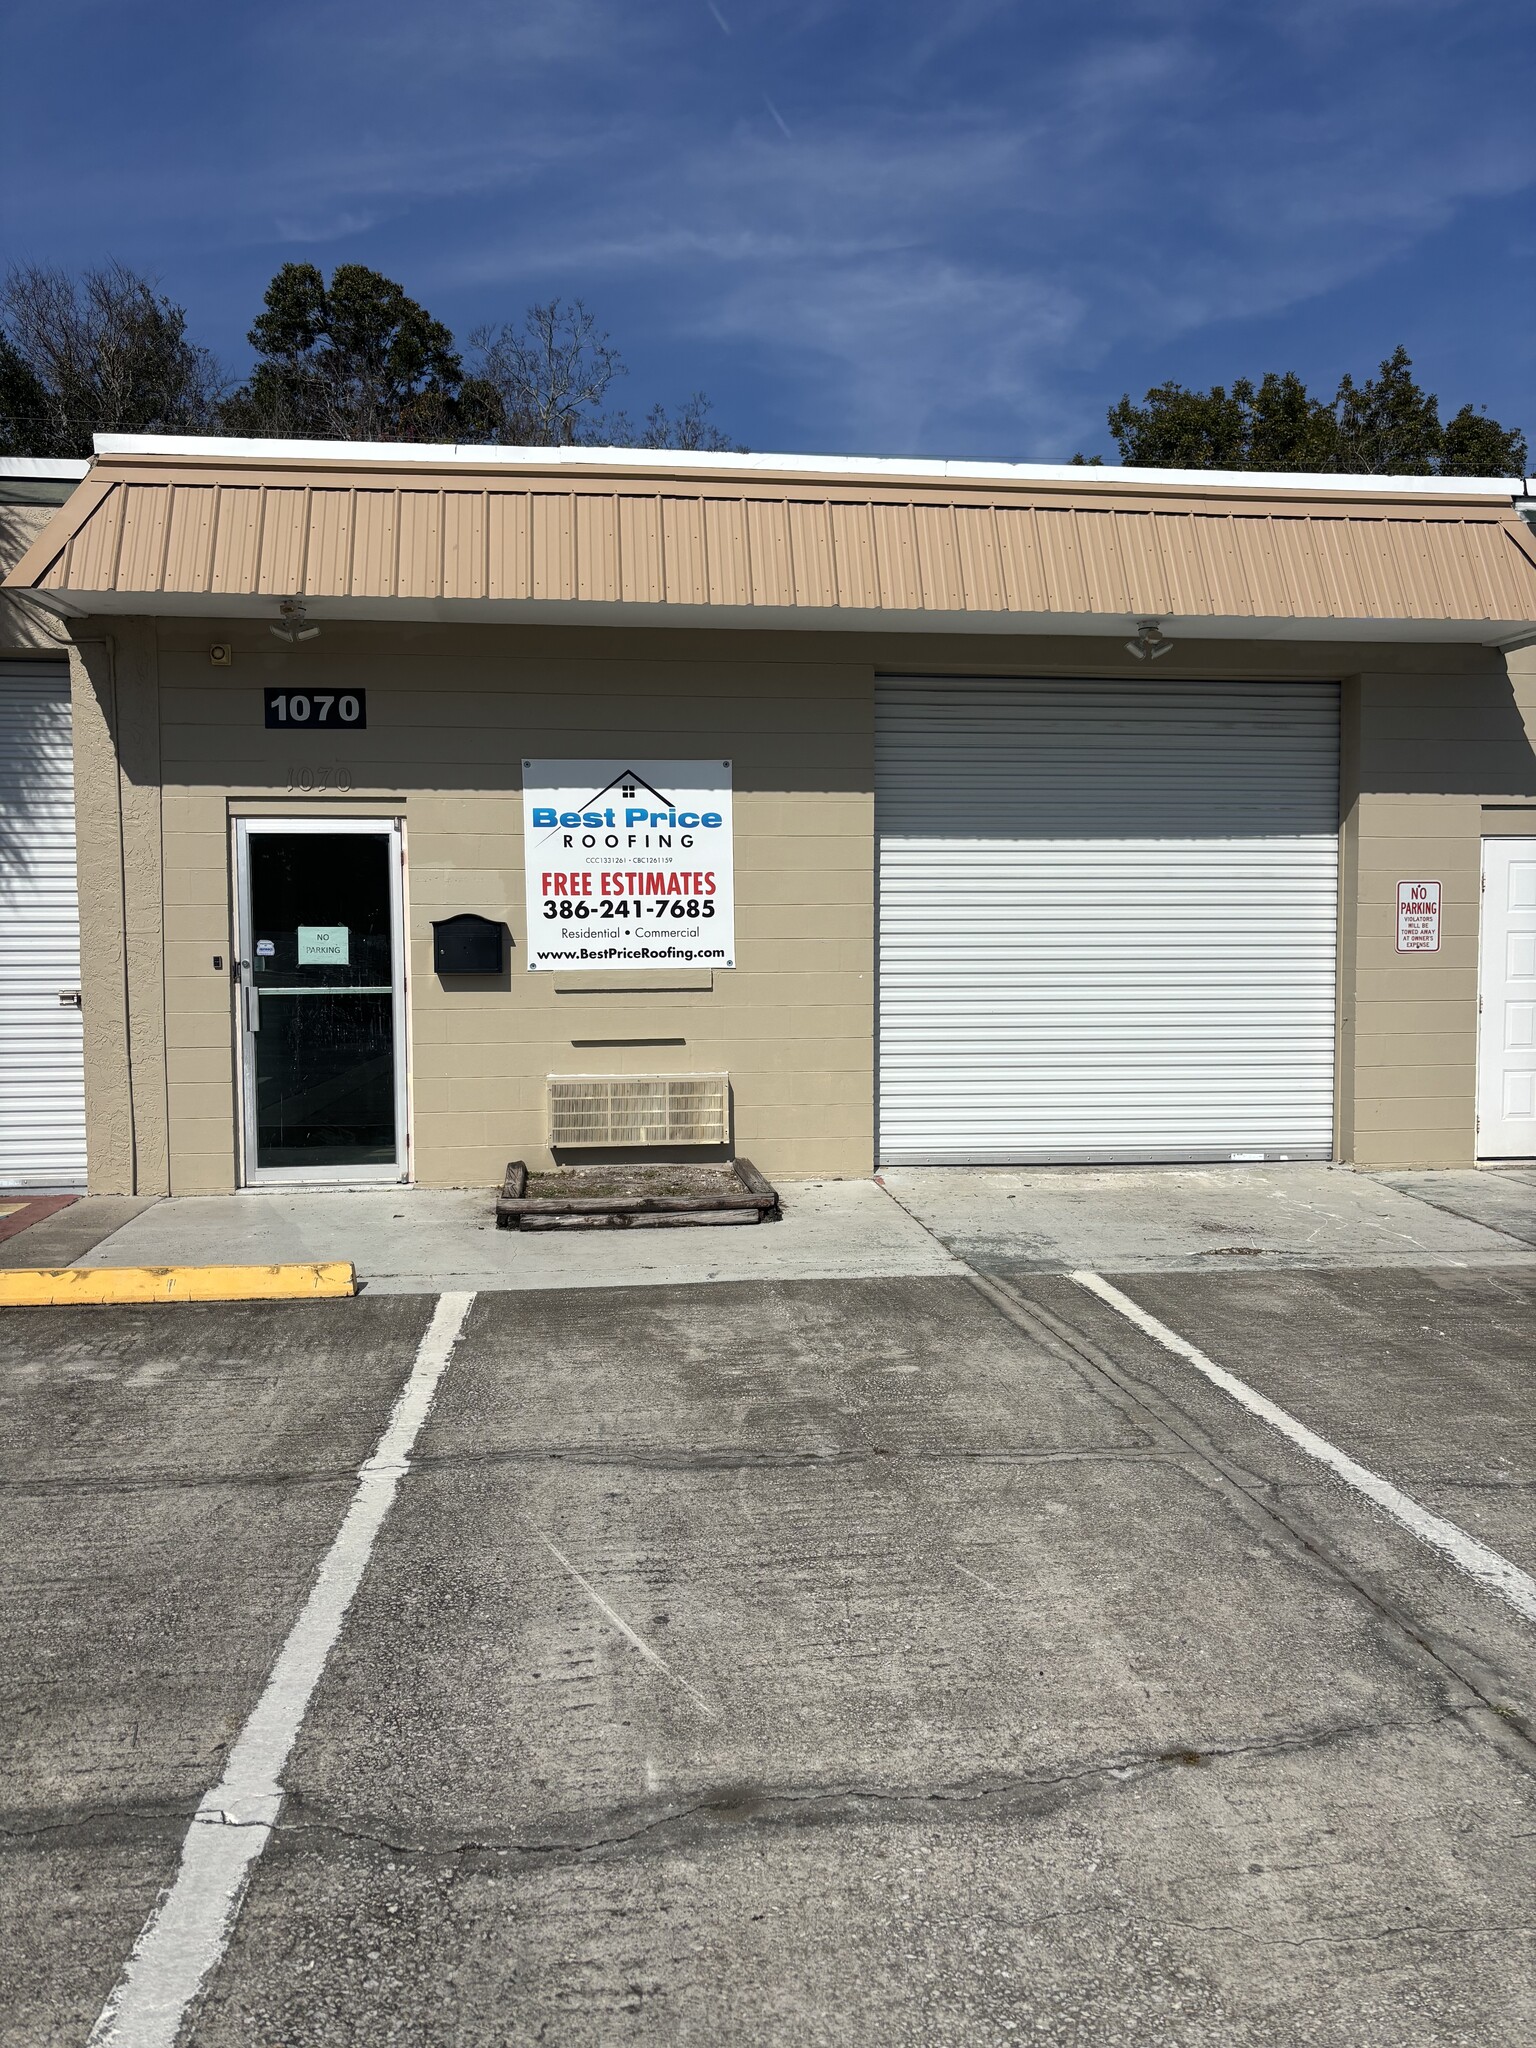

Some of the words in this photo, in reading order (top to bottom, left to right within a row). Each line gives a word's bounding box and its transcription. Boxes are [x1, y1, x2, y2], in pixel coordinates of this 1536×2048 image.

[271, 695, 360, 722] 1070
[286, 766, 352, 793] 1070
[532, 808, 616, 829] Best
[625, 808, 723, 829] Price
[563, 834, 694, 848] ROOFING
[541, 872, 592, 896] FREE
[600, 871, 716, 896] ESTIMATES
[1411, 887, 1427, 900] NO
[543, 899, 715, 919] 386-241-7685
[1400, 902, 1437, 915] PARKING
[316, 933, 330, 941] NO
[561, 927, 620, 939] Residential
[635, 926, 700, 938] Commercial
[306, 946, 341, 954] PARKING
[537, 947, 725, 961] www.BestPriceRoofing.com
